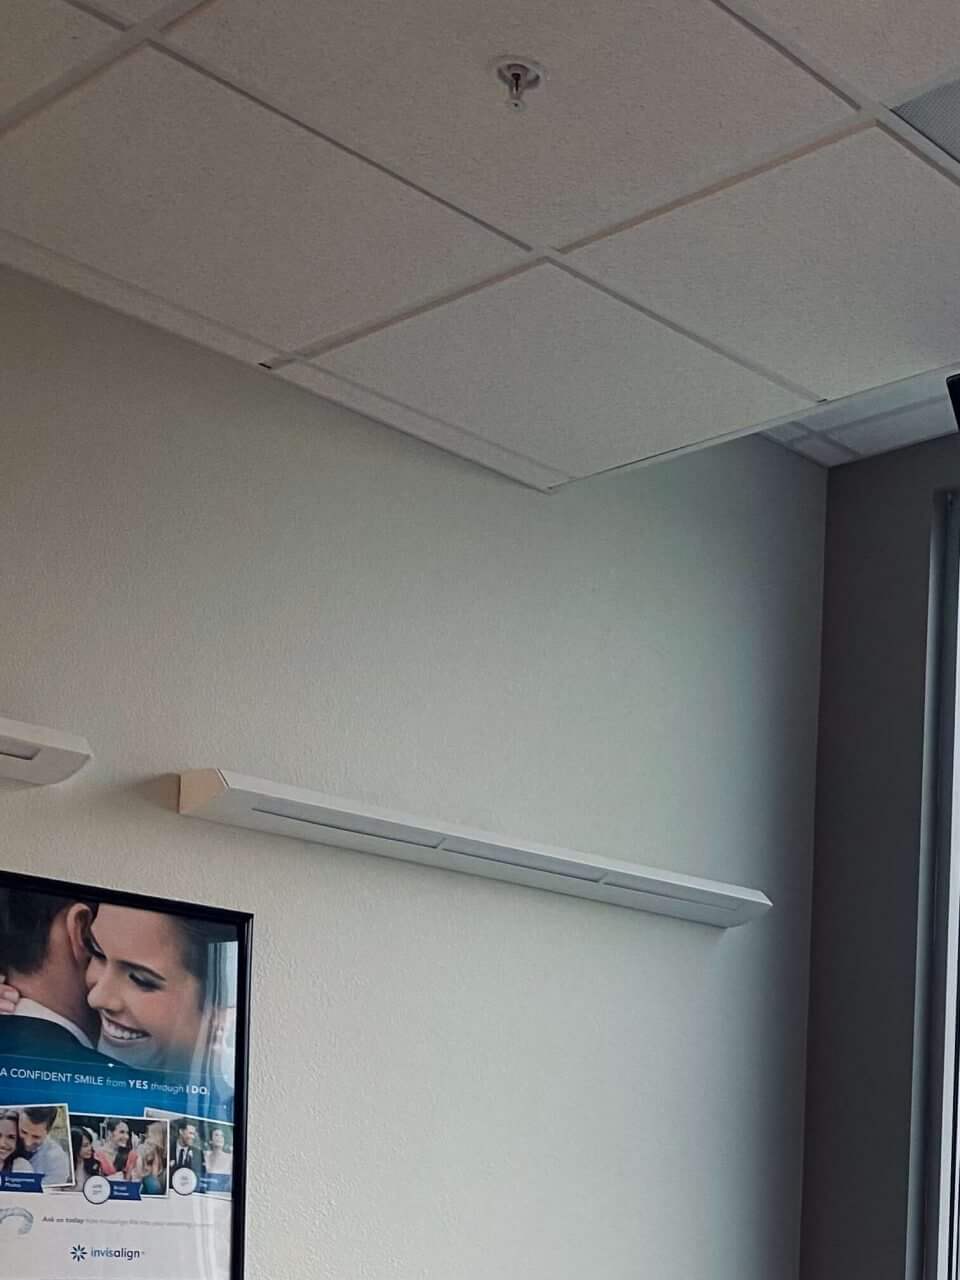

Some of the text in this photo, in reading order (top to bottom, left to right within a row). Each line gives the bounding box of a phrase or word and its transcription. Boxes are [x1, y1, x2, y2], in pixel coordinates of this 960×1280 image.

[0, 1067, 8, 1077] A
[10, 1068, 72, 1083] CONFIDENT
[74, 1074, 104, 1086] SMILE
[106, 1077, 126, 1087] from
[128, 1079, 148, 1090] YES
[151, 1082, 184, 1095] through
[91, 1247, 140, 1261] invisalign
